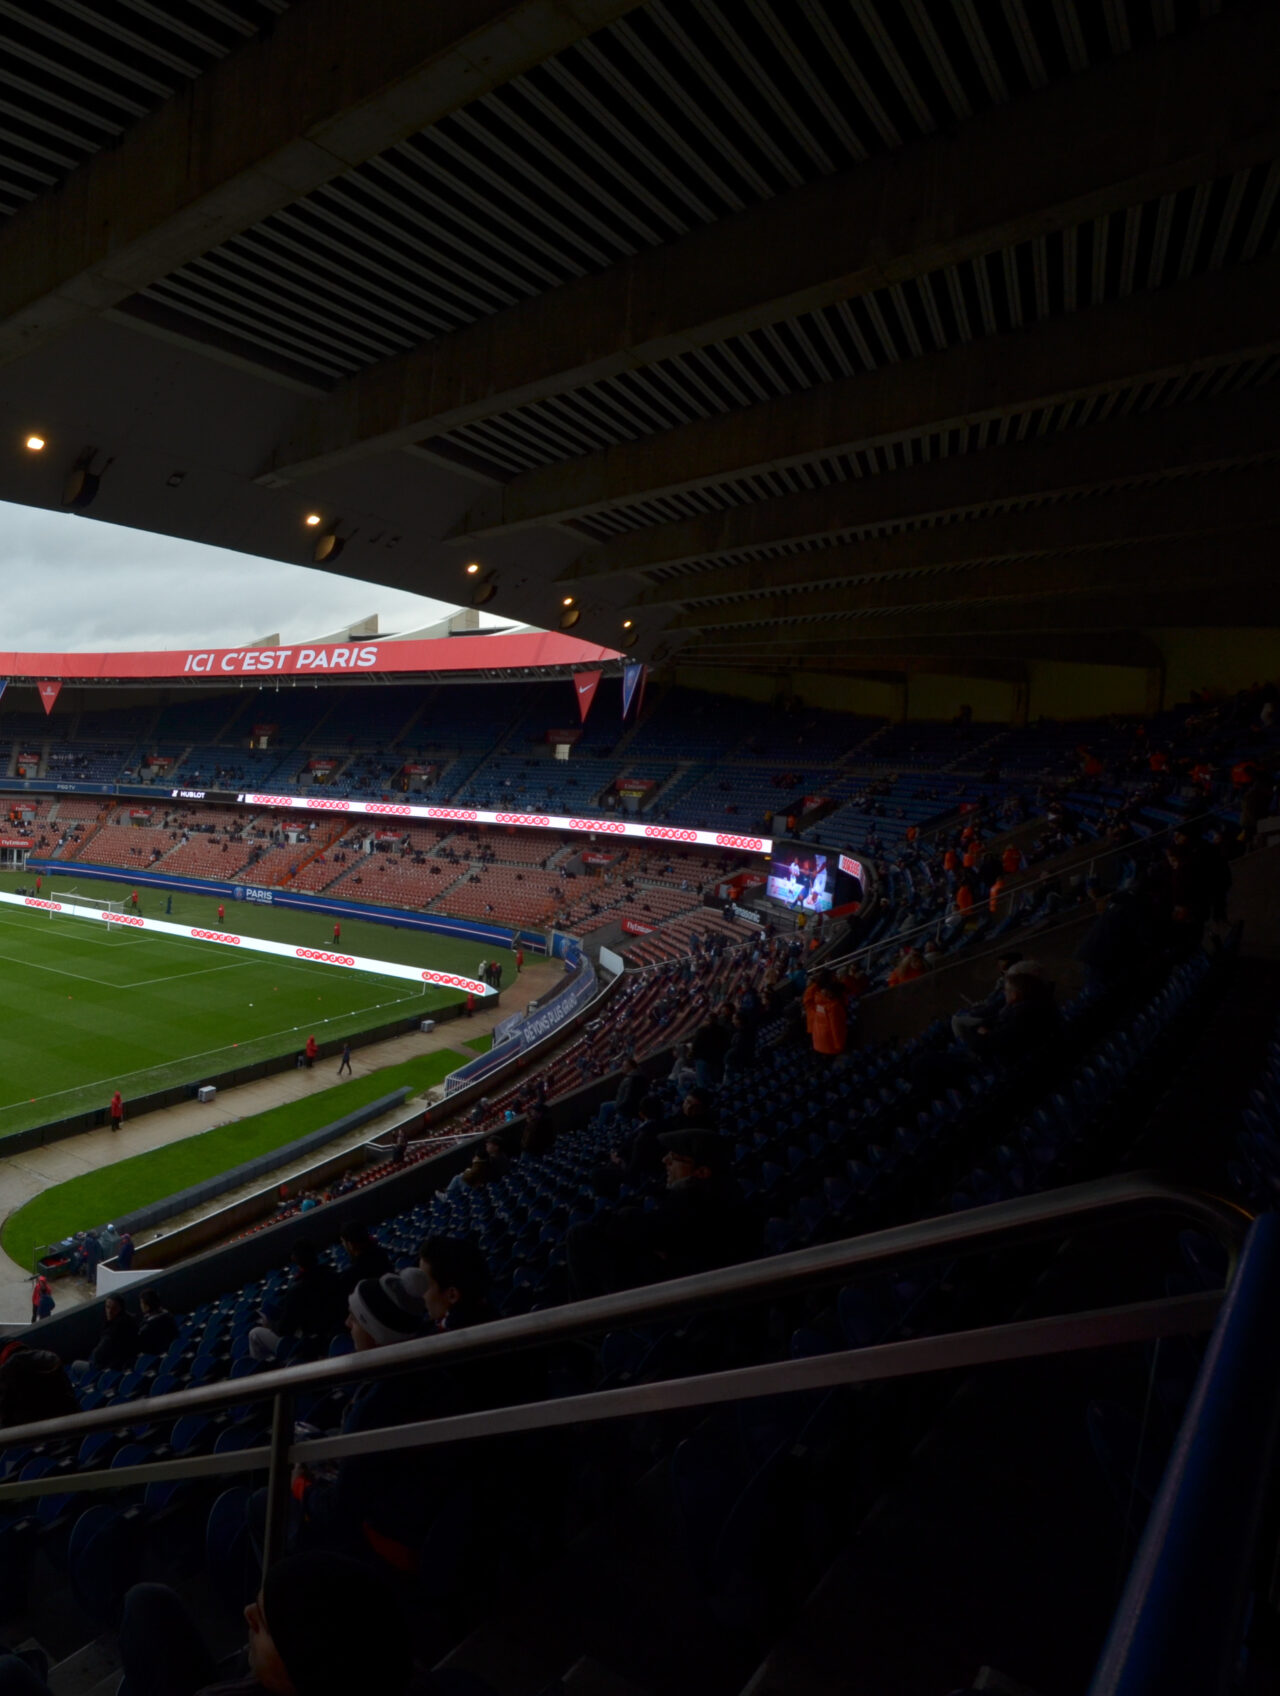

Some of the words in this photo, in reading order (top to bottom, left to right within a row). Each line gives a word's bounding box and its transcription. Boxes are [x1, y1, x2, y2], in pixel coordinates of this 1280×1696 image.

[184, 654, 215, 672] ICI
[221, 650, 292, 671] C'EST
[296, 647, 378, 669] PARIS
[180, 791, 206, 799] HUBLOT
[252, 795, 293, 806] ooredoo
[307, 799, 350, 811] ooredoo
[365, 804, 411, 815] ooredoo
[428, 809, 477, 820] ooredoo
[495, 813, 550, 826] ooredoo
[569, 819, 626, 833] ooredoo
[645, 826, 698, 842] ooredoo
[716, 834, 763, 850] ooredoo
[246, 889, 273, 900] PARIS
[25, 898, 62, 911] ooredoo
[102, 912, 144, 927] ooredoo
[191, 929, 241, 945] ooredoo
[296, 948, 355, 967] ooredoo
[422, 971, 485, 993] ooredoo
[547, 1005, 564, 1024] PLUS
